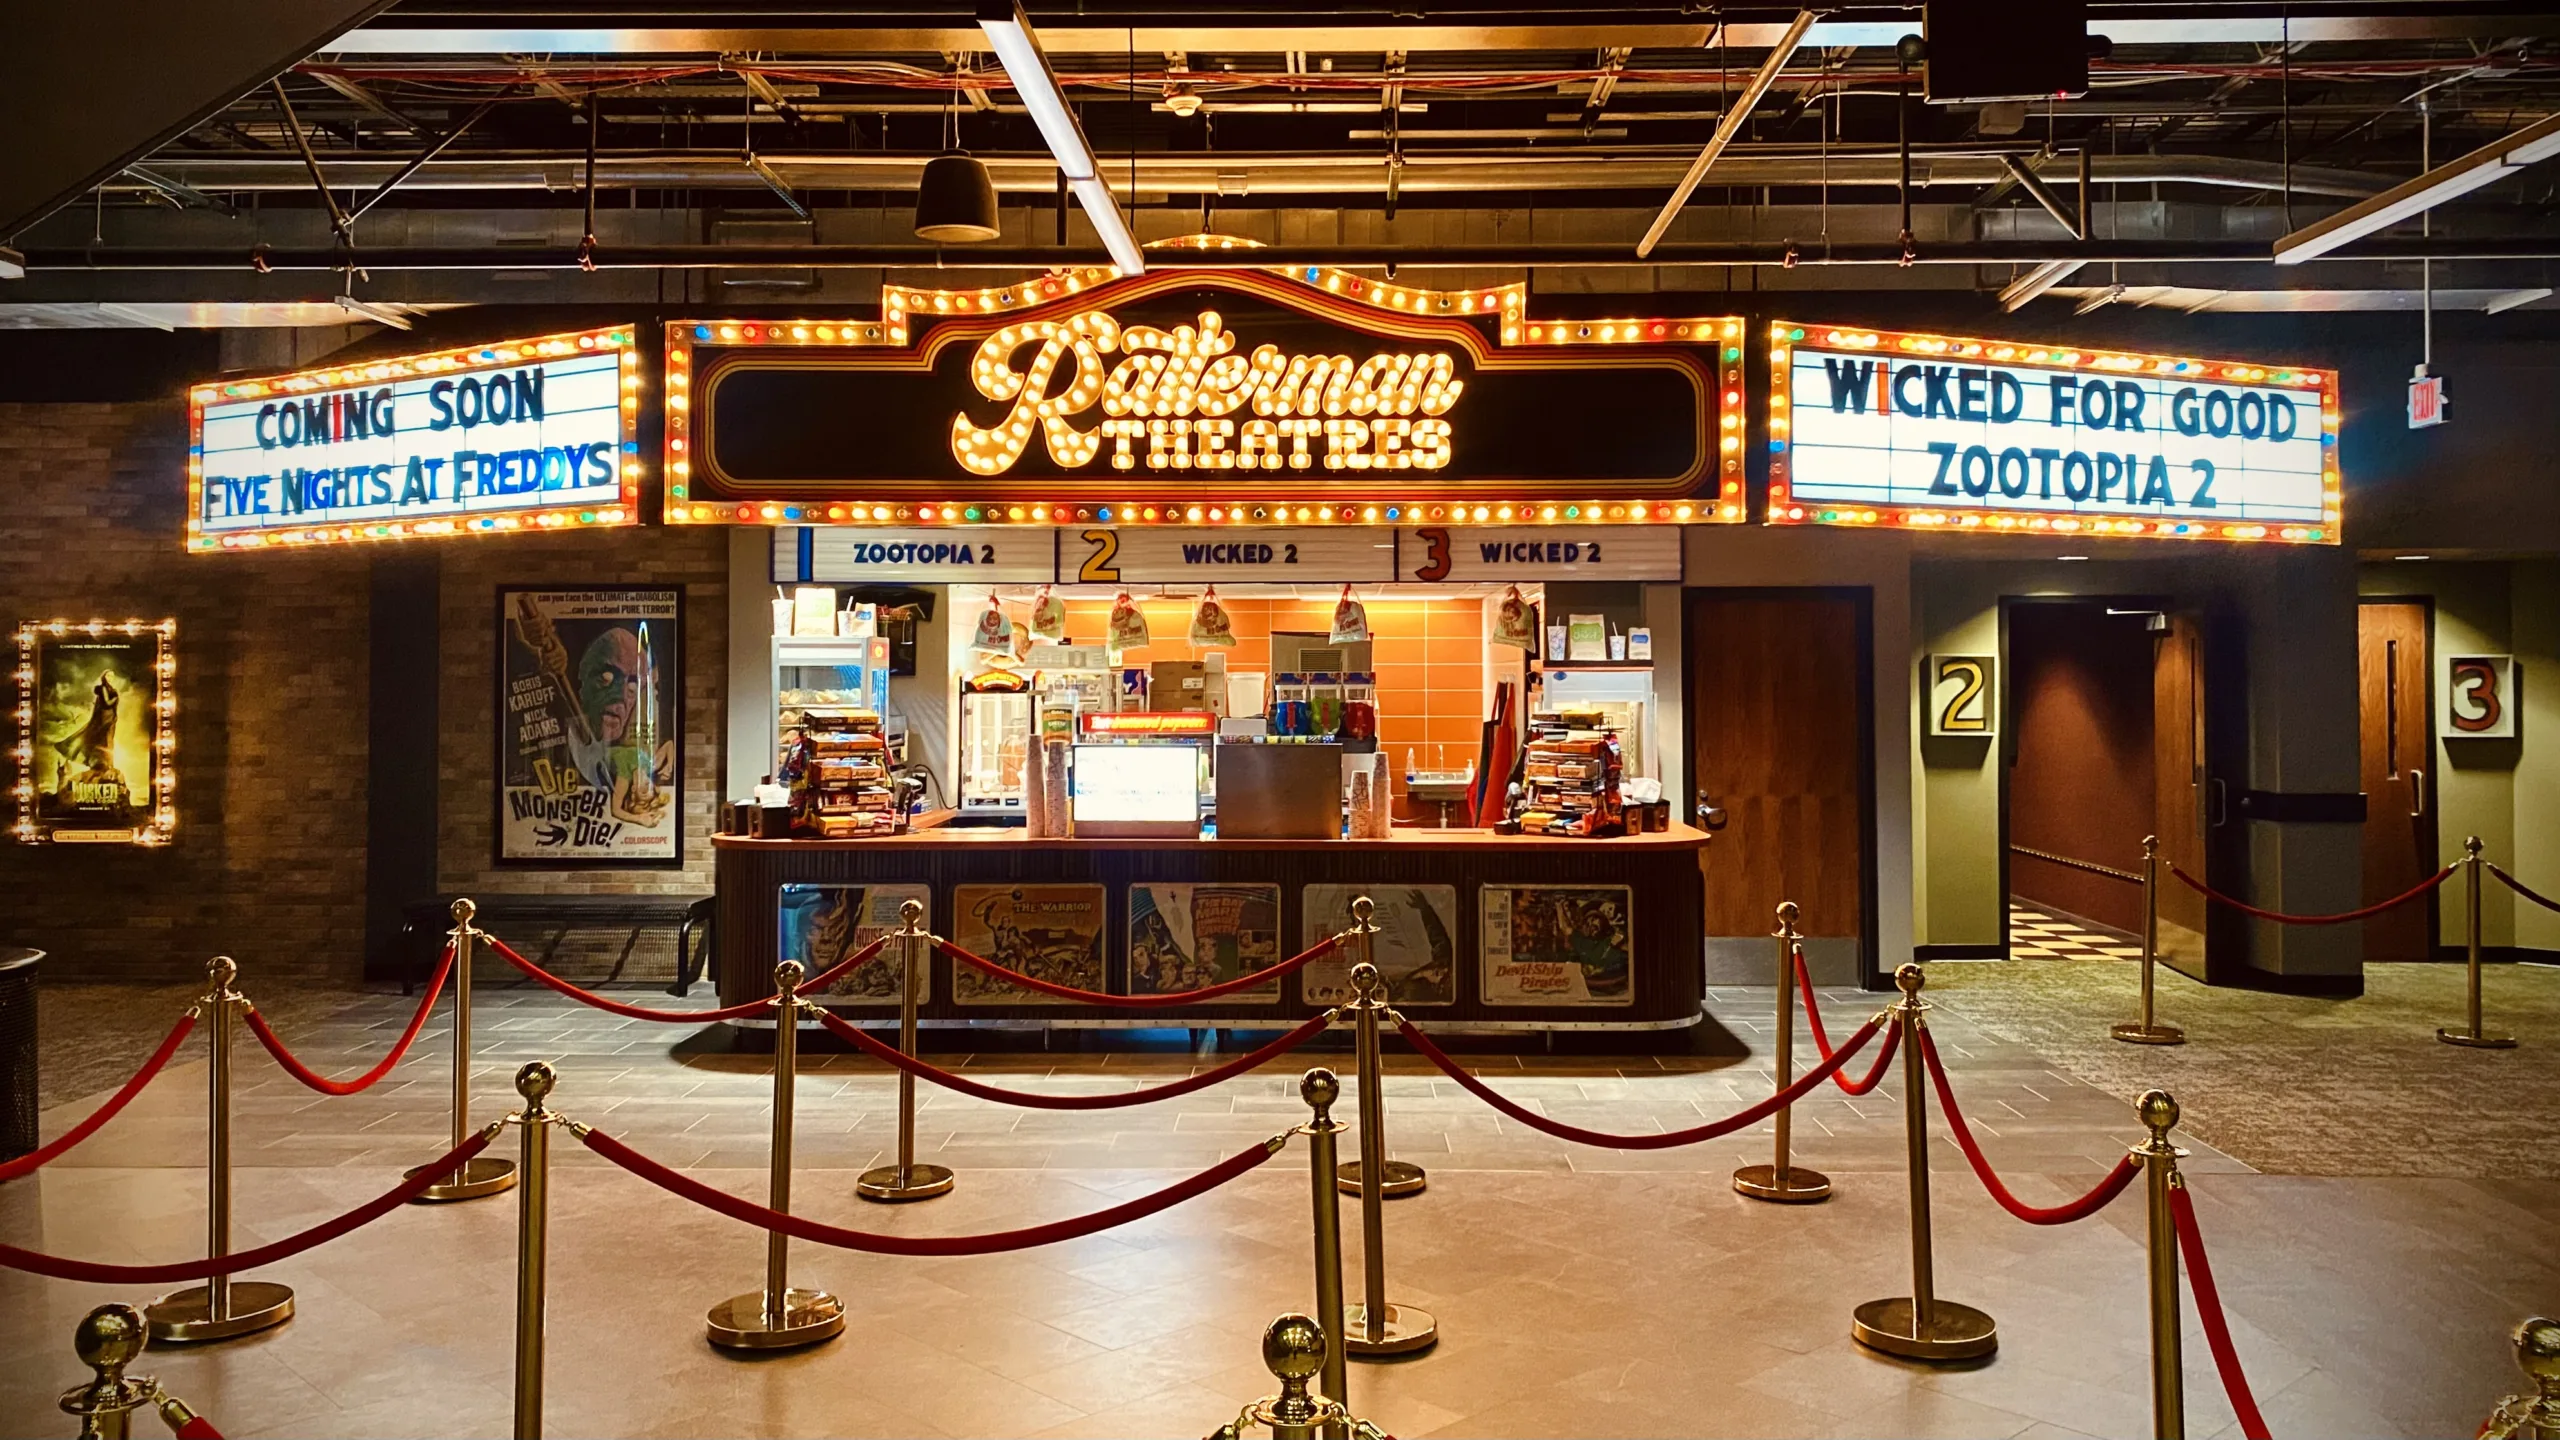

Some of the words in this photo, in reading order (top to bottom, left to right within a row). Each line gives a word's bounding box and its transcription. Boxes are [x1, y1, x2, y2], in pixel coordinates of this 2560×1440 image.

[256, 389, 394, 451] COMING
[430, 368, 545, 430] SOON
[952, 311, 1463, 476] Ratterman
[1824, 358, 2023, 424] WICKED
[2050, 375, 2146, 433] FOR
[2172, 387, 2297, 443] GOOD
[1101, 419, 1452, 469] THEATRES
[204, 475, 270, 522] FIVE
[281, 464, 393, 514] NIGHTS
[400, 456, 444, 506] AT
[453, 441, 613, 503] FREDDYS
[1927, 441, 2174, 507] ZOOTOPIA
[2190, 458, 2217, 508] 2
[853, 543, 974, 564] ZOOTOPIA
[980, 544, 995, 564] 2
[1079, 529, 1121, 582] 2
[1181, 543, 1274, 564] WICKED
[1284, 544, 1298, 564] 2
[1414, 528, 1452, 582] 3
[1480, 542, 1580, 563] WICKED
[1586, 542, 1602, 563] 2
[621, 604, 640, 614] PURE
[508, 686, 555, 712] KARLOFF
[512, 675, 542, 694] BORIS
[1938, 659, 1987, 732] 2
[2452, 660, 2500, 732] 3
[519, 718, 560, 743] ADAMS
[523, 707, 548, 724] NICK
[532, 758, 578, 796] Die
[573, 815, 623, 848] Die!
[624, 836, 668, 845] COLORSCOPE
[1012, 902, 1039, 913] THE
[1040, 902, 1092, 912] WARRIOR
